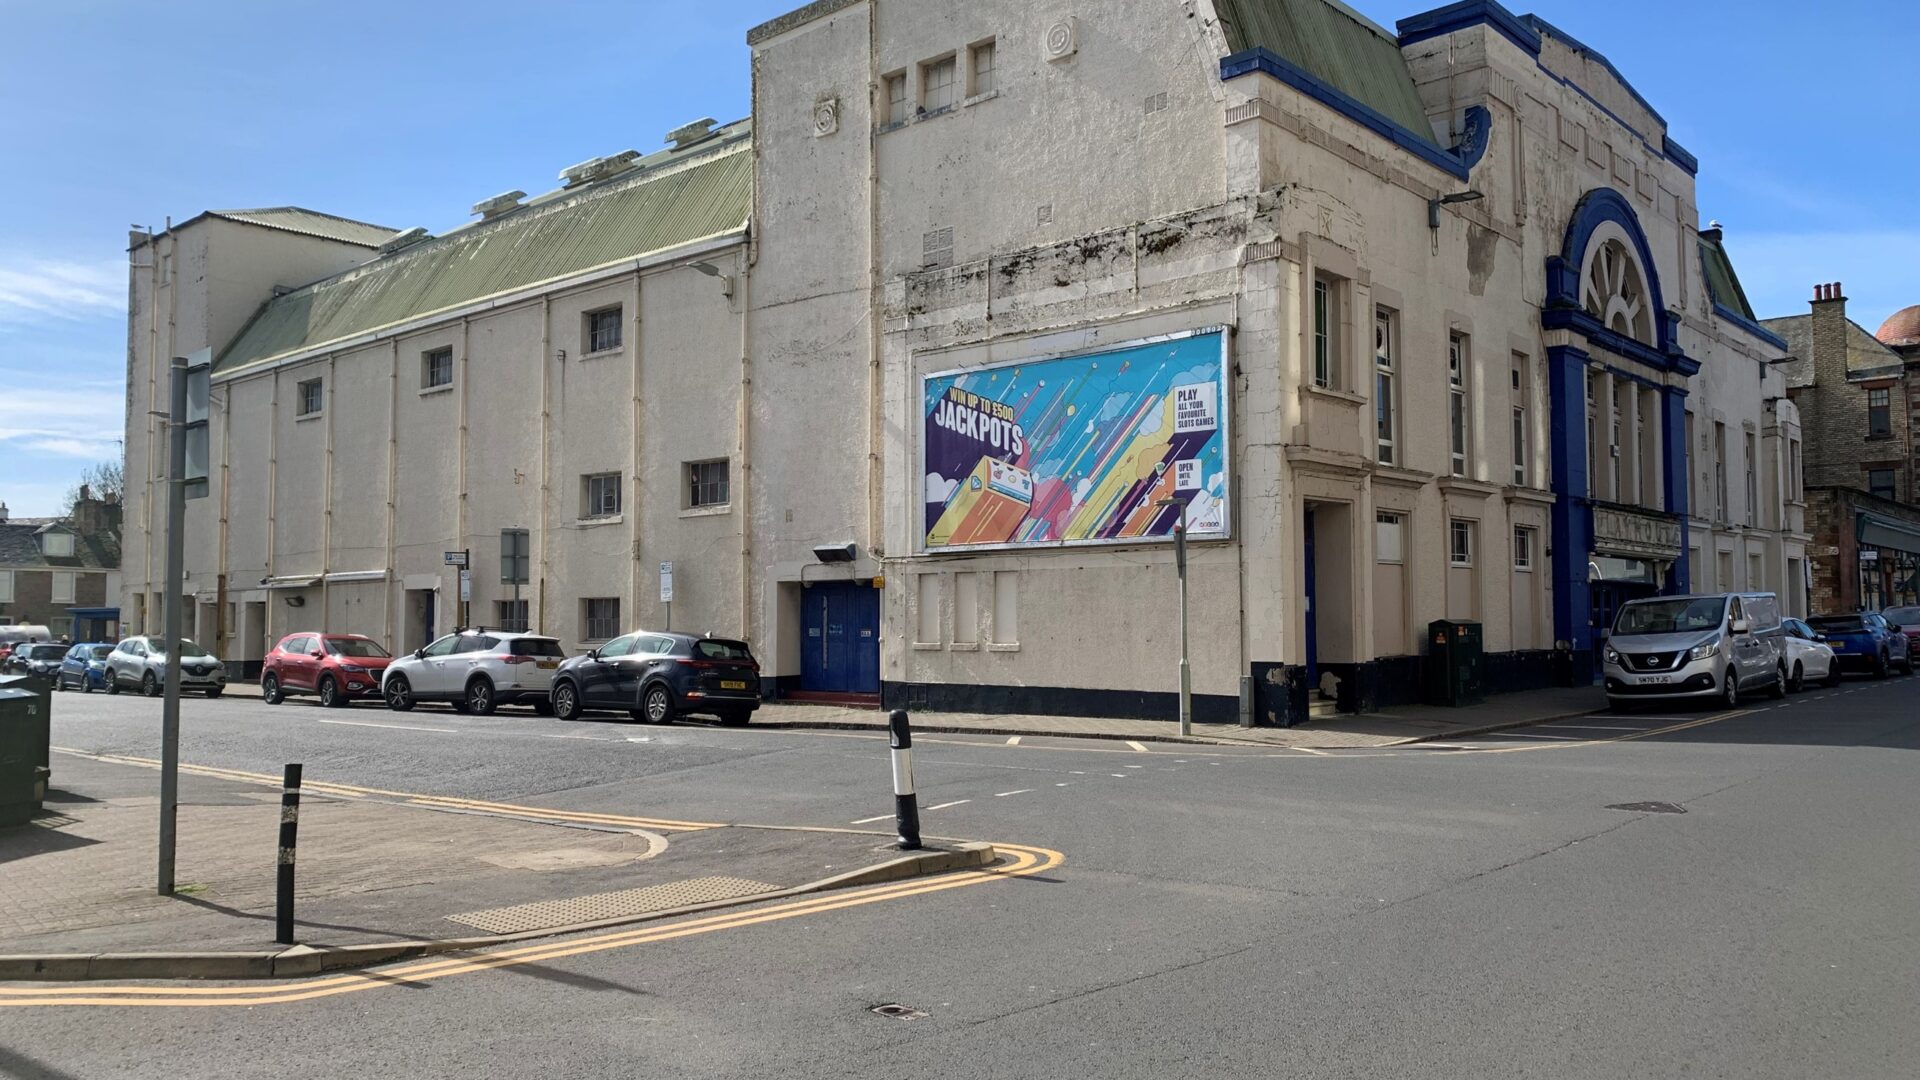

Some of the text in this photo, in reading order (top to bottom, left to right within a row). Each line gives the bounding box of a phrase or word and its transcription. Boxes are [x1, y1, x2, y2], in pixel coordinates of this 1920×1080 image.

[1178, 388, 1198, 401] PLAY
[950, 388, 1014, 421] WIN UP TO £500
[1189, 401, 1203, 409] YOUR
[1178, 409, 1206, 419] FAVOURITE
[935, 398, 1023, 456] JACKPOTS
[1178, 417, 1214, 428] SLOTS GAMES
[1179, 463, 1193, 472] OPEN
